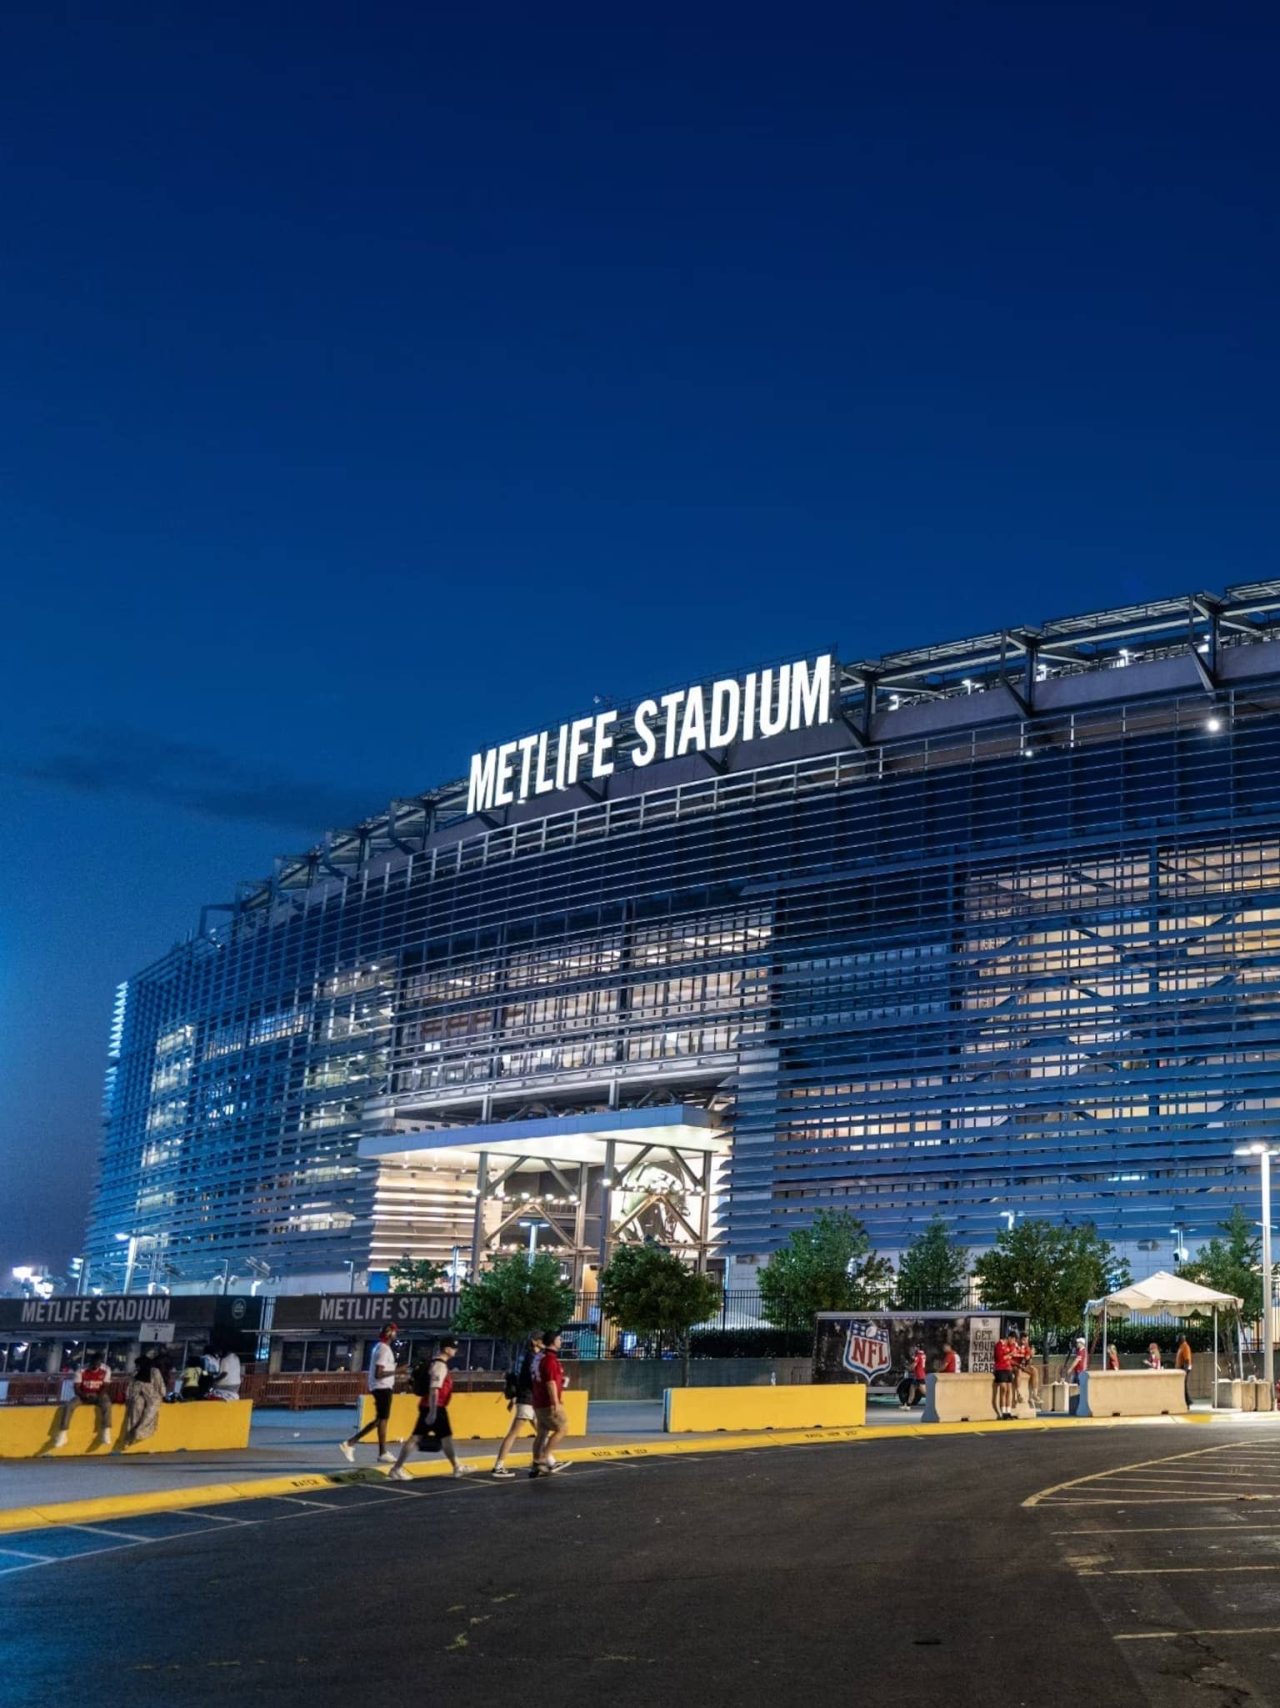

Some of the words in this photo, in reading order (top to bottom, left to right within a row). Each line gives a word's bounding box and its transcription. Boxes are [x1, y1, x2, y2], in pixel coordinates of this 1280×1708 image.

[466, 709, 618, 815] METLIFE
[630, 653, 832, 768] STADIUM
[21, 1301, 92, 1322] METLIFE
[95, 1298, 171, 1321] STADIUM
[319, 1297, 394, 1320] METLIFE
[398, 1297, 462, 1319] STADIU
[975, 1330, 993, 1341] GET
[851, 1336, 888, 1369] NFL
